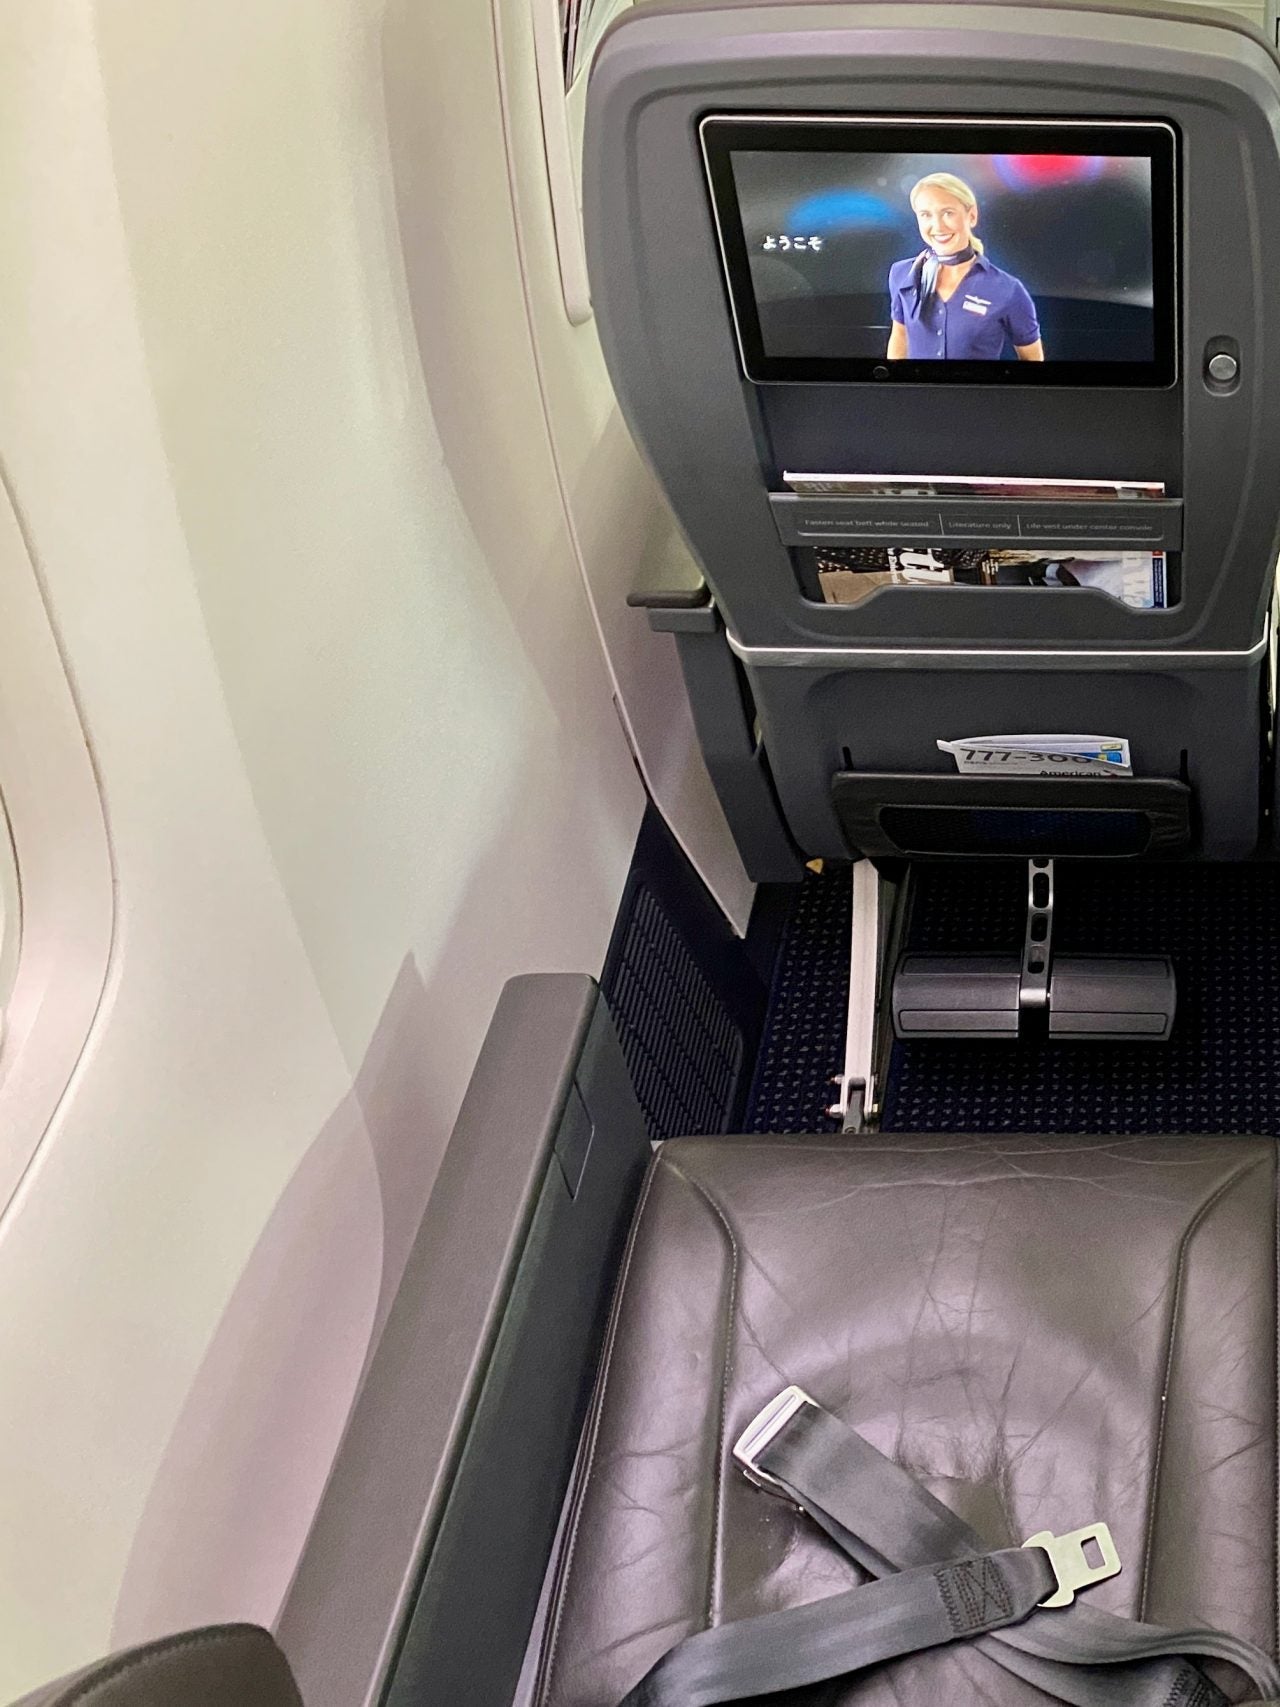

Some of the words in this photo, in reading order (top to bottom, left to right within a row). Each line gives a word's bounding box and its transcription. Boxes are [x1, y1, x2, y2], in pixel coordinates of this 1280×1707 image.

[763, 235, 823, 251] ようこそ
[804, 519, 834, 527] Fasten
[835, 519, 854, 527] seat
[855, 519, 873, 527] belt
[900, 520, 929, 528] seated
[948, 521, 991, 529] Literature
[992, 522, 1012, 531] only
[1026, 522, 1041, 530] Life
[1089, 523, 1117, 531] center
